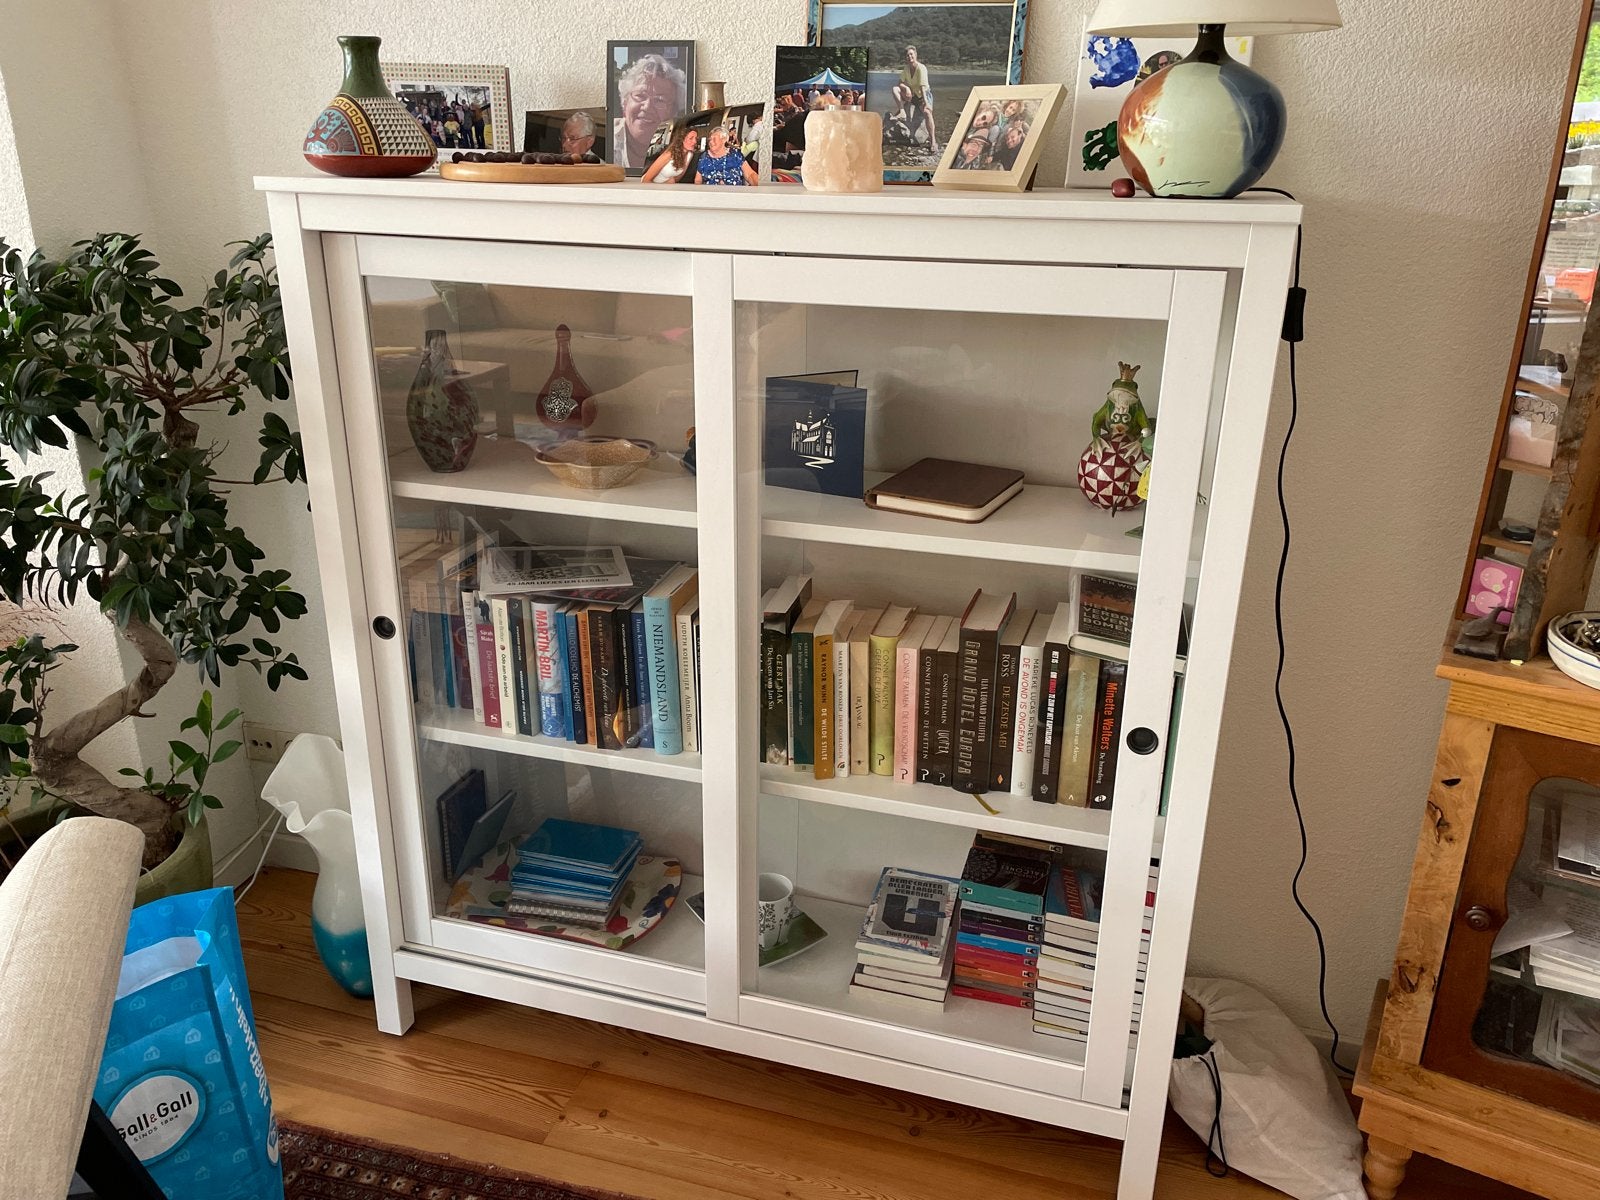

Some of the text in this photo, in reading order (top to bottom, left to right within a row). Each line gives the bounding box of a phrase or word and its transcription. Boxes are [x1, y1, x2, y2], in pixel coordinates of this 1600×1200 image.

[1085, 576, 1114, 585] PETER
[1083, 618, 1132, 633] BOMEN
[1084, 612, 1128, 626] LEVEN
[534, 609, 552, 681] MARTIN BRIL
[680, 622, 688, 646] JUDITH
[767, 647, 774, 656] De
[568, 625, 582, 712] PAULO COELHO DE ALCHEMIST
[652, 623, 669, 722] NIEMANDSLAND
[681, 648, 690, 691] KOELEMEIJER
[766, 657, 774, 676] levens
[902, 653, 910, 680] CONNIE
[924, 656, 932, 685] CONNIE
[1031, 658, 1040, 689] MARIEKE
[875, 677, 881, 685] DE
[684, 695, 692, 712] Anna
[902, 681, 910, 708] PALMEN
[979, 692, 988, 715] LEONARD
[999, 653, 1011, 748] ROSS DE ZESDE MEI
[1017, 657, 1031, 753] DE AVOND IS ONGEMAK
[1029, 691, 1037, 714] LUCAS
[1104, 682, 1119, 716] Minette
[821, 708, 827, 716] DE
[957, 640, 981, 774] GRAND HOTEL EUROPA
[1076, 715, 1083, 723] De
[923, 720, 930, 729] DE
[1100, 718, 1114, 751] Walters
[900, 721, 909, 764] VRIENDSCHAP
[922, 731, 930, 760] WETTEN
[1096, 760, 1105, 784] branding
[888, 882, 911, 890] ALLER
[895, 888, 934, 899] VERENIGT
[133, 1125, 159, 1143] SINDS
